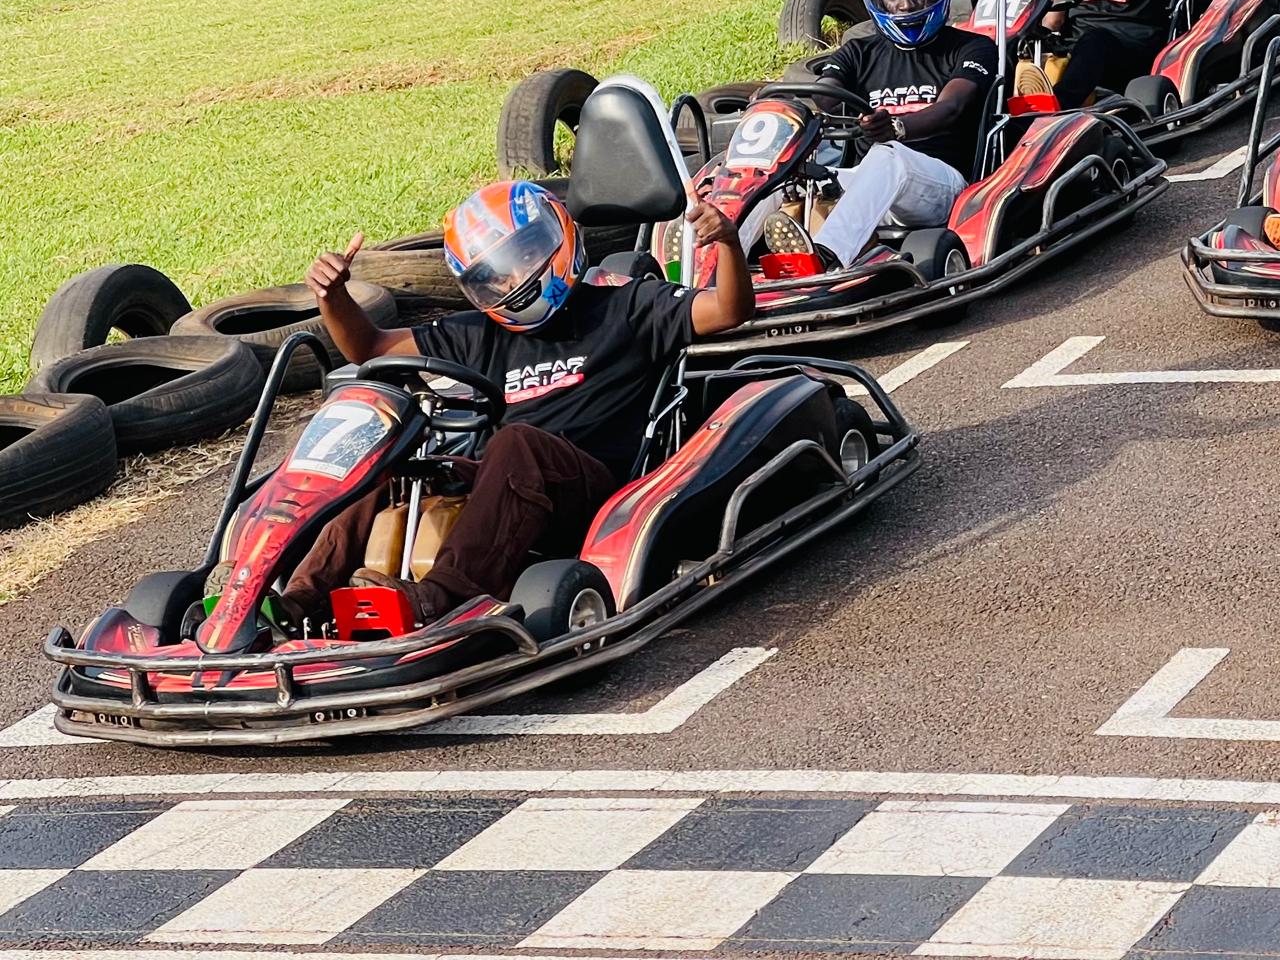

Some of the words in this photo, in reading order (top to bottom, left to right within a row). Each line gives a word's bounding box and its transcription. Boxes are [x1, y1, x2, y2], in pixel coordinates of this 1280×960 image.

[735, 113, 779, 155] 9
[547, 283, 569, 306] XL
[306, 405, 375, 460] 7
